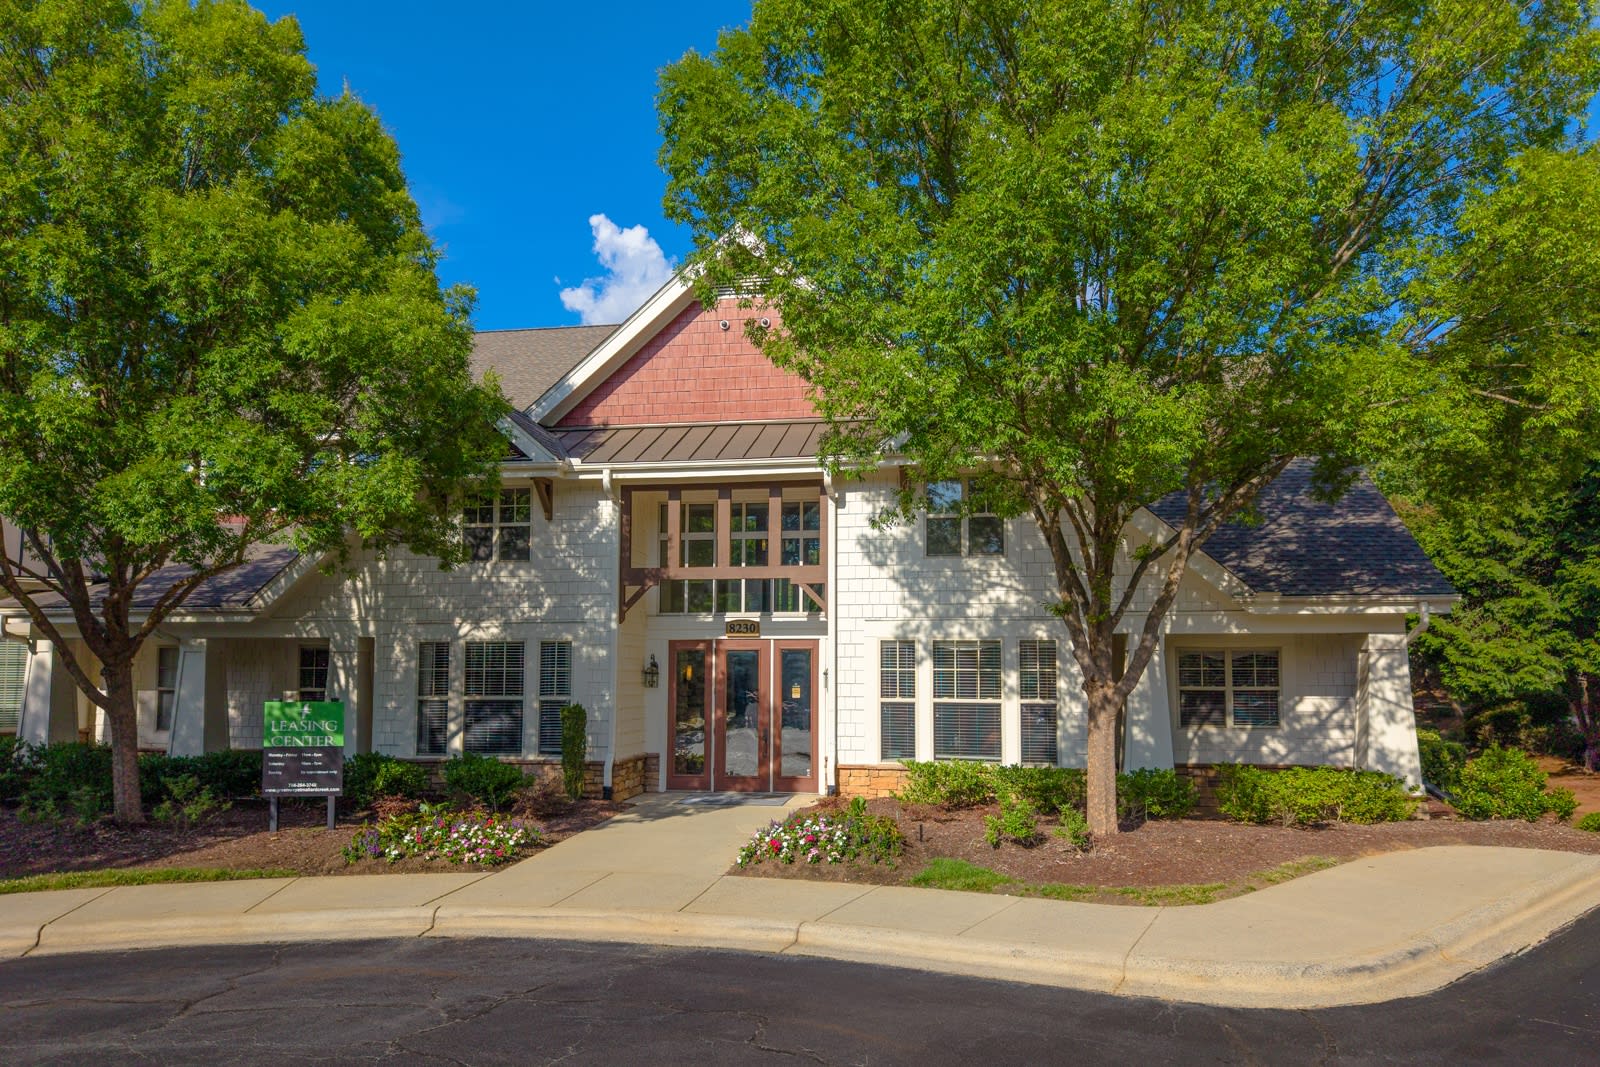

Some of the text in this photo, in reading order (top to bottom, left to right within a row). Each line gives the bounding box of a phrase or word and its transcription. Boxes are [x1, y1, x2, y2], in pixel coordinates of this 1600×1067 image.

[729, 623, 756, 634] 8230
[271, 720, 338, 732] LEASING
[271, 735, 337, 747] CENTER
